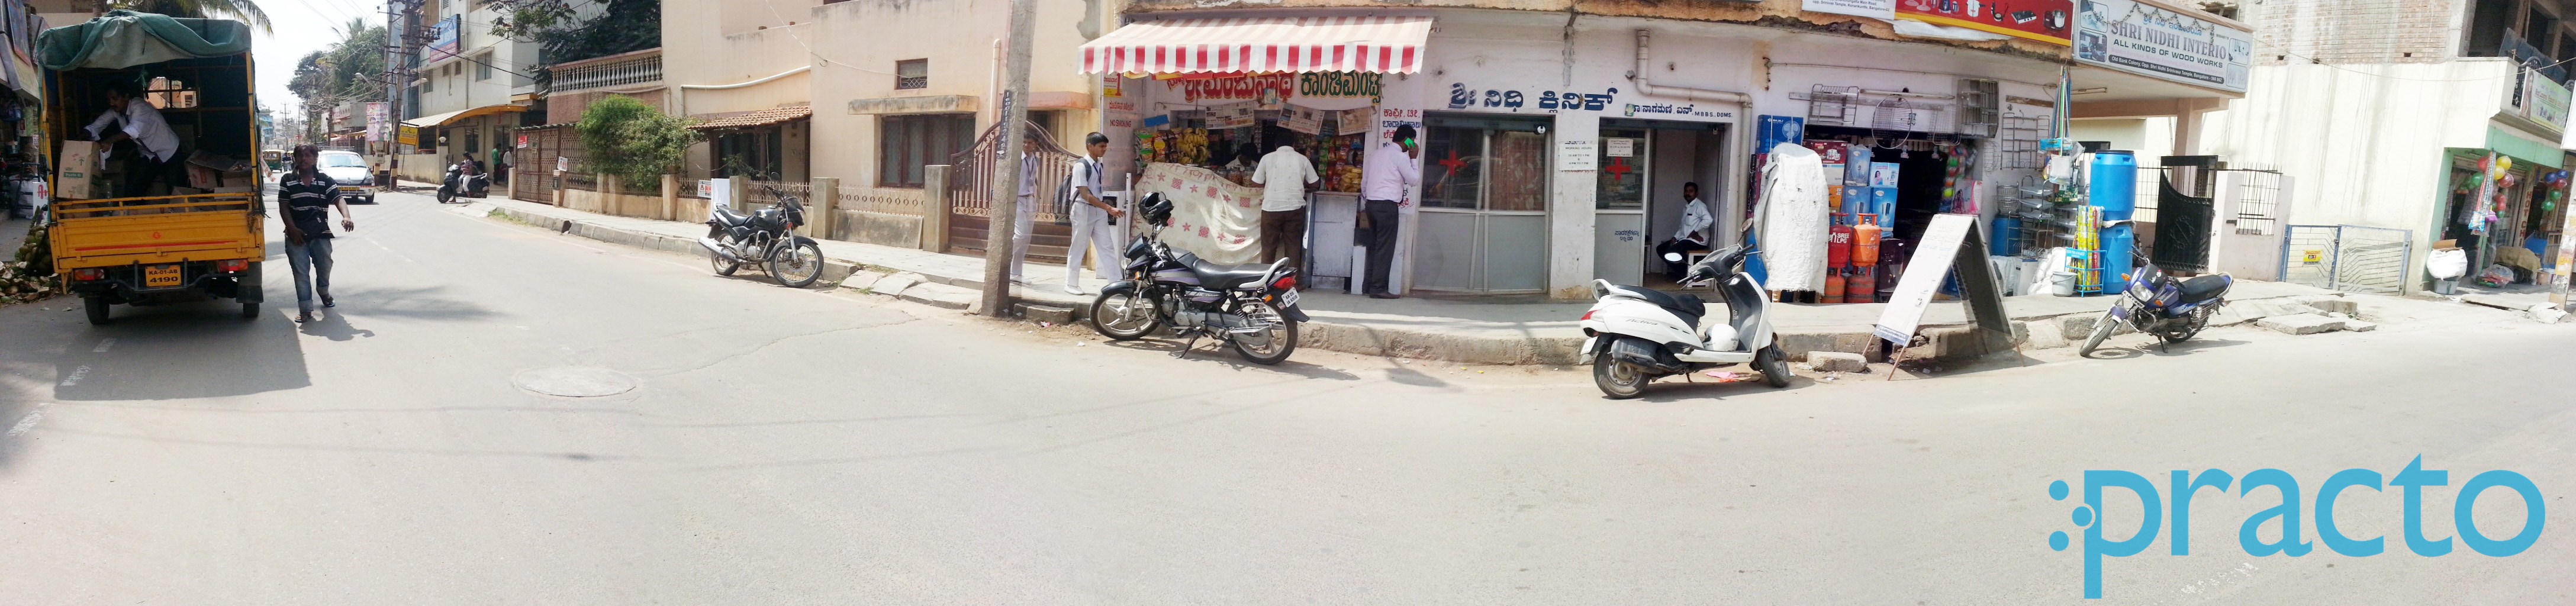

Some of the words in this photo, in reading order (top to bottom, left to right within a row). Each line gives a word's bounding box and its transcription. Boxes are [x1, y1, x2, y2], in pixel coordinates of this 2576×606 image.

[2111, 20, 2143, 40] SHRI
[2146, 27, 2181, 49] NIDHI
[2183, 37, 2227, 59] INTERIO
[2114, 39, 2129, 47] ALL
[2132, 43, 2156, 53] KINDS
[2172, 51, 2194, 62] WOOD
[2197, 57, 2223, 68] WORKS
[1448, 82, 1477, 109] ಶ್ರೀ
[1483, 89, 1524, 112] ನಿಧಿ
[1539, 87, 1618, 114] ಕ್ಲಿನಿಕ್
[1116, 120, 1131, 128] SMOKING
[2523, 192, 2532, 219] HOT
